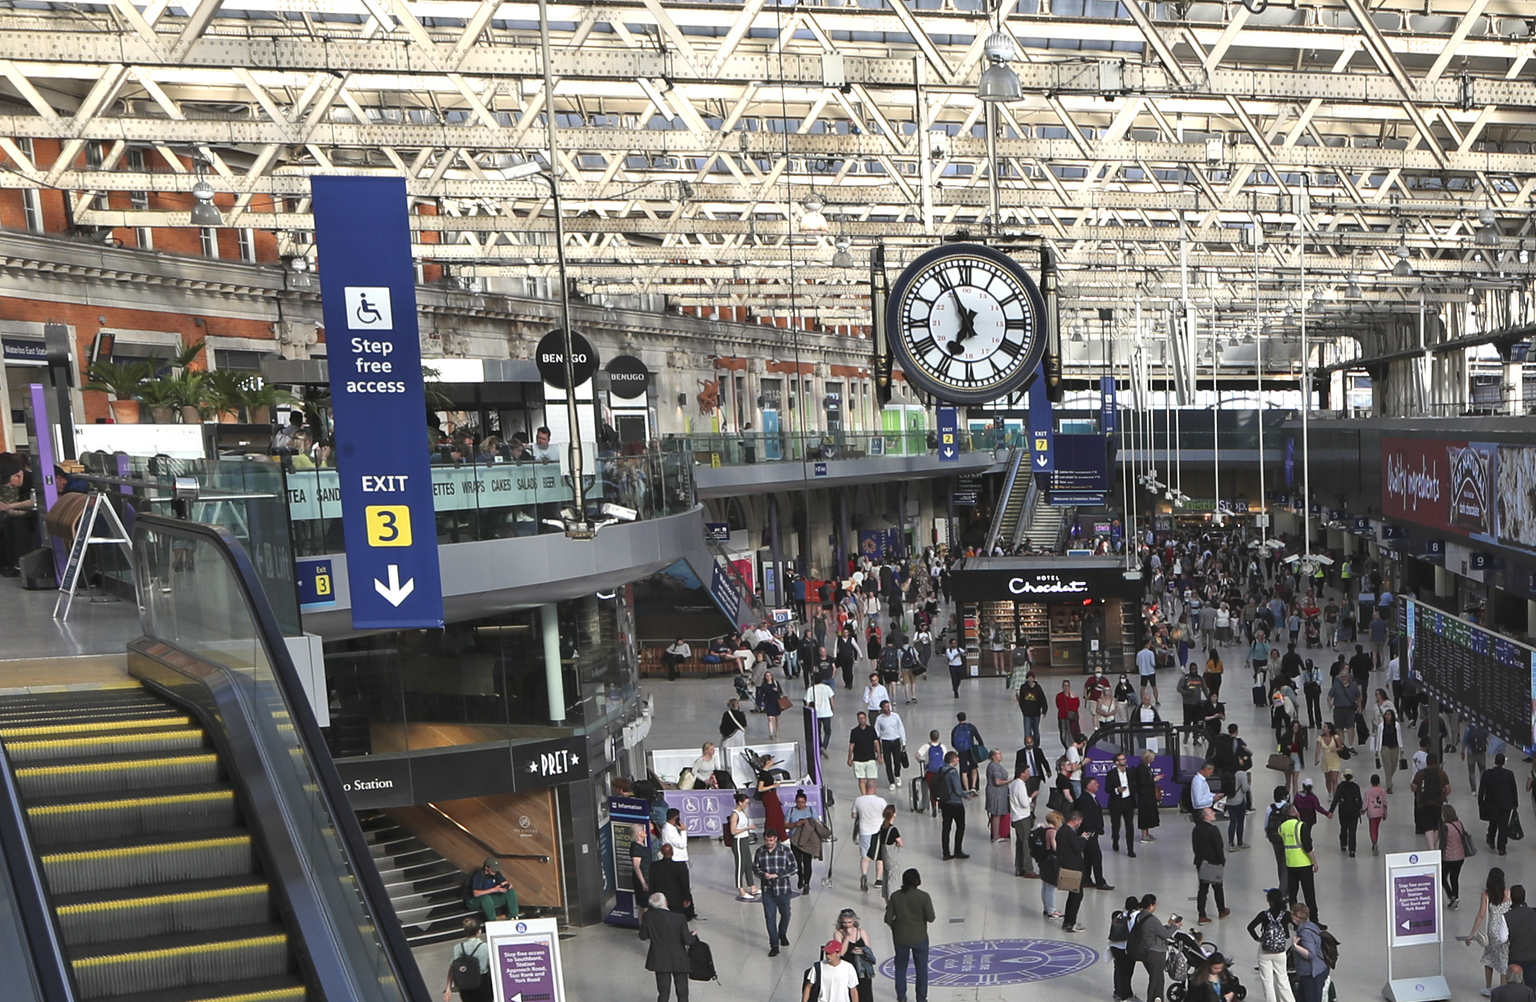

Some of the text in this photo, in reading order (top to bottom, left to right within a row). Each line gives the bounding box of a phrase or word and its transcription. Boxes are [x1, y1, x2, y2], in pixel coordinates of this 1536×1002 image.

[351, 337, 393, 357] Step
[542, 353, 587, 363] BENGO
[355, 357, 392, 373] free
[611, 373, 645, 381] BENUGO
[346, 381, 406, 393] access
[1038, 440, 1045, 449] 7
[361, 475, 408, 492] EXIT
[1387, 453, 1440, 511] Quality ingredients
[287, 489, 306, 504] TEA
[461, 480, 485, 494] WRAPS
[491, 479, 511, 492] CAKES
[516, 477, 537, 490] SALADS
[542, 477, 555, 488] BEER
[376, 510, 399, 542] 3
[1432, 542, 1439, 552] 8
[1477, 556, 1484, 566] 9
[315, 566, 327, 574] Exit
[319, 577, 327, 593] 3
[540, 750, 568, 776] PRET
[354, 778, 393, 791] Station
[618, 802, 643, 811] Information
